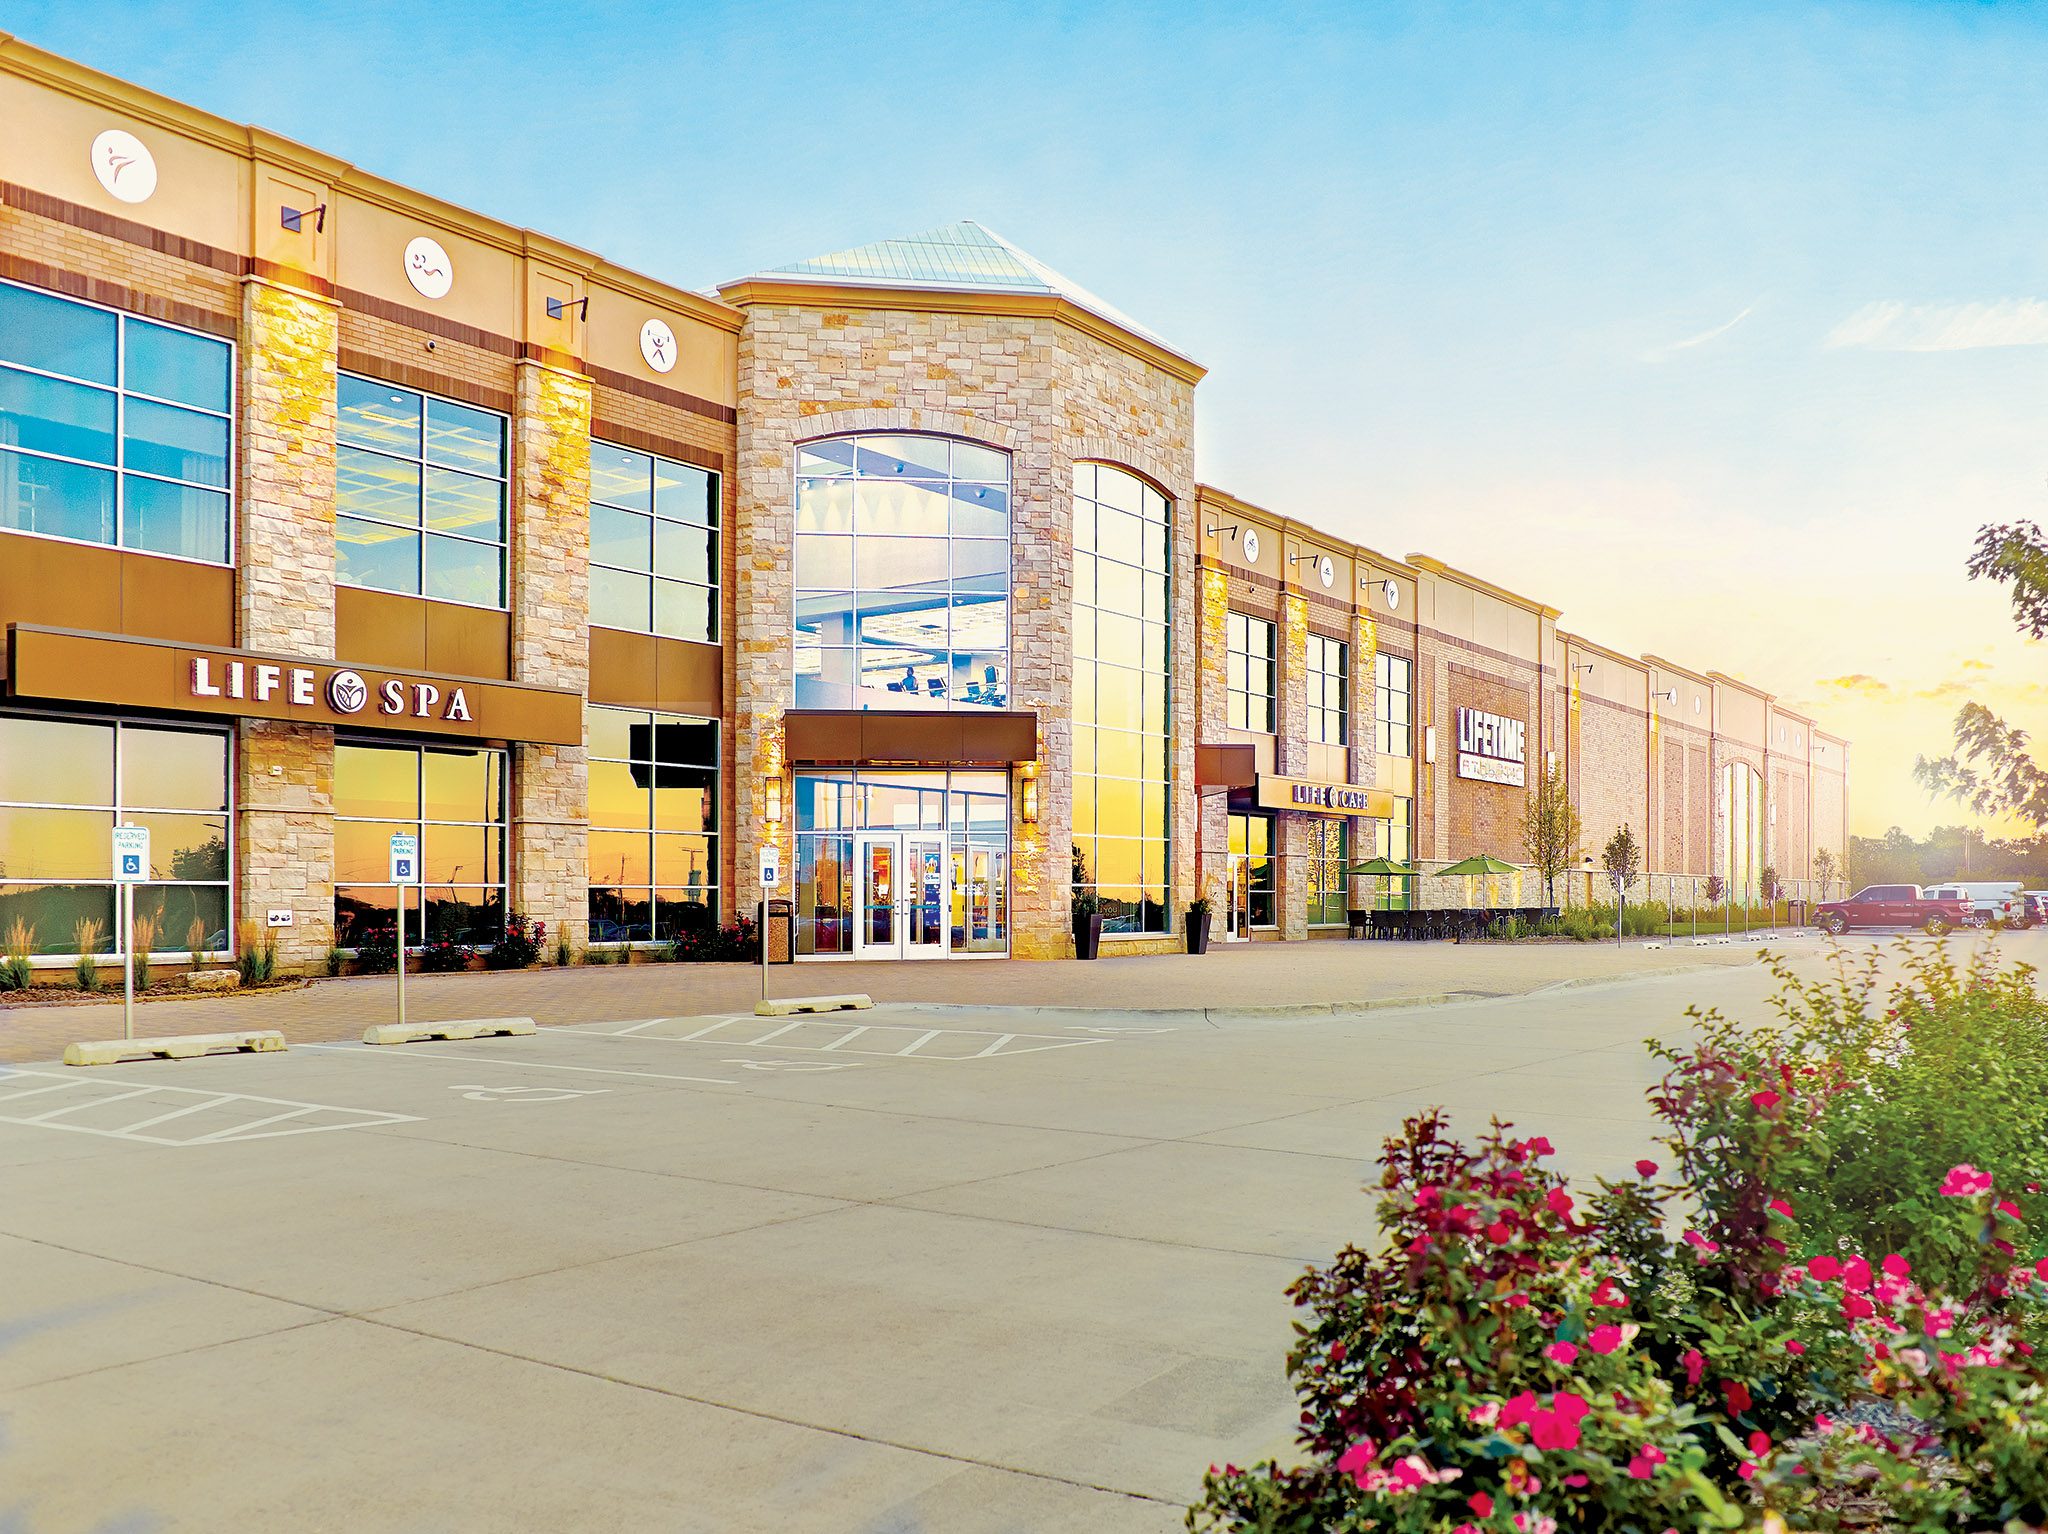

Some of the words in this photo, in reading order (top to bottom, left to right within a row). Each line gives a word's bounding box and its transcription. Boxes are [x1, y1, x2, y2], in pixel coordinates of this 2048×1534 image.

[192, 656, 315, 706] LIFE
[379, 679, 473, 721] SPA
[1458, 706, 1525, 764] LIFETIME
[1293, 784, 1326, 805] LIFE
[1339, 790, 1368, 809] CAFE
[118, 841, 144, 849] PARKING
